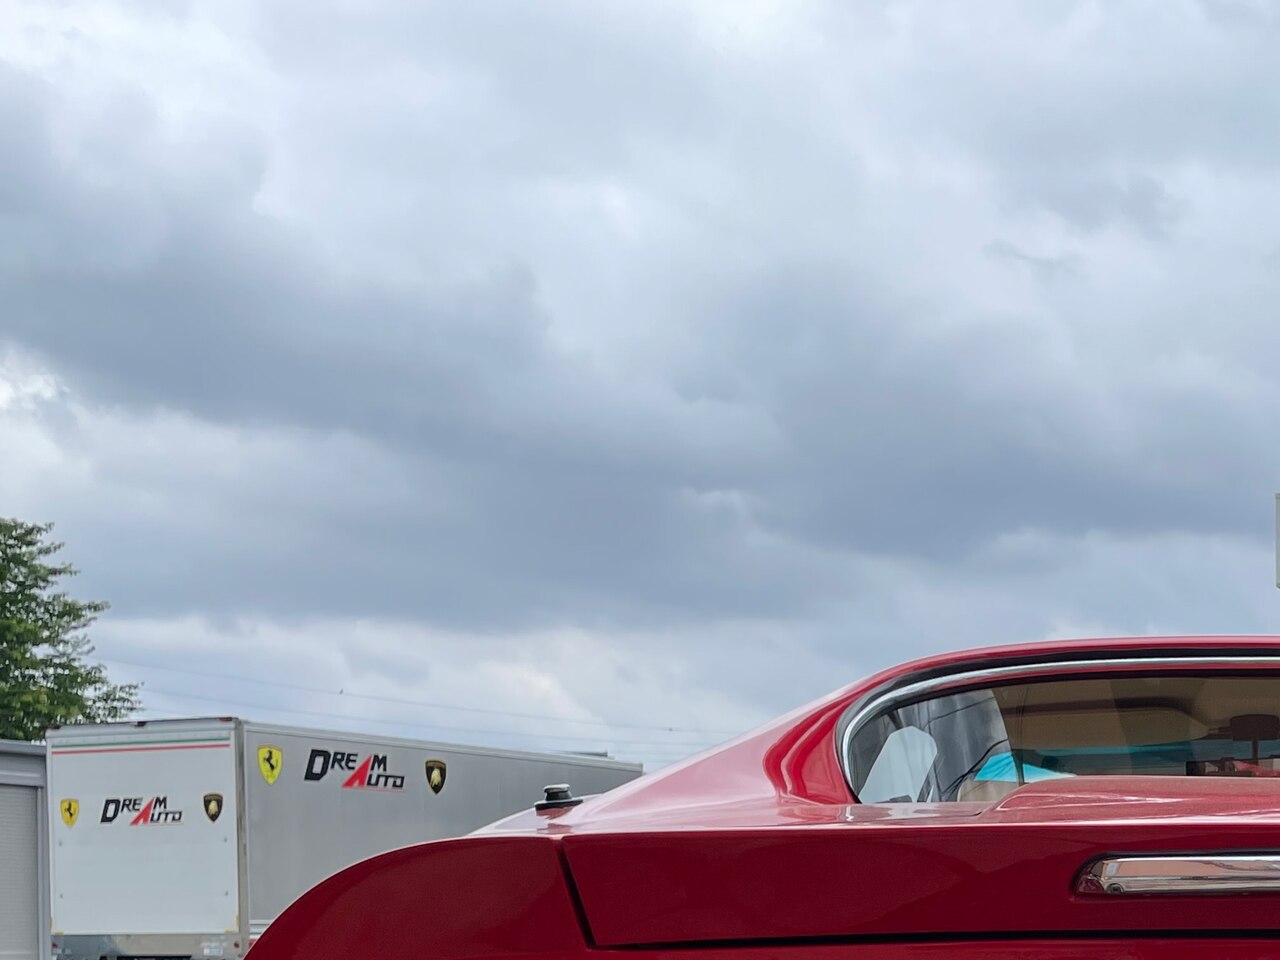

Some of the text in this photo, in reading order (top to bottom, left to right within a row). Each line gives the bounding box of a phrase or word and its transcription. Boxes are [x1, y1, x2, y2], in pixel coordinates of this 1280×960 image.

[304, 748, 388, 788] DREAM
[342, 754, 405, 789] AUTO
[100, 796, 167, 826] DREAM
[129, 796, 183, 826] AUTO
